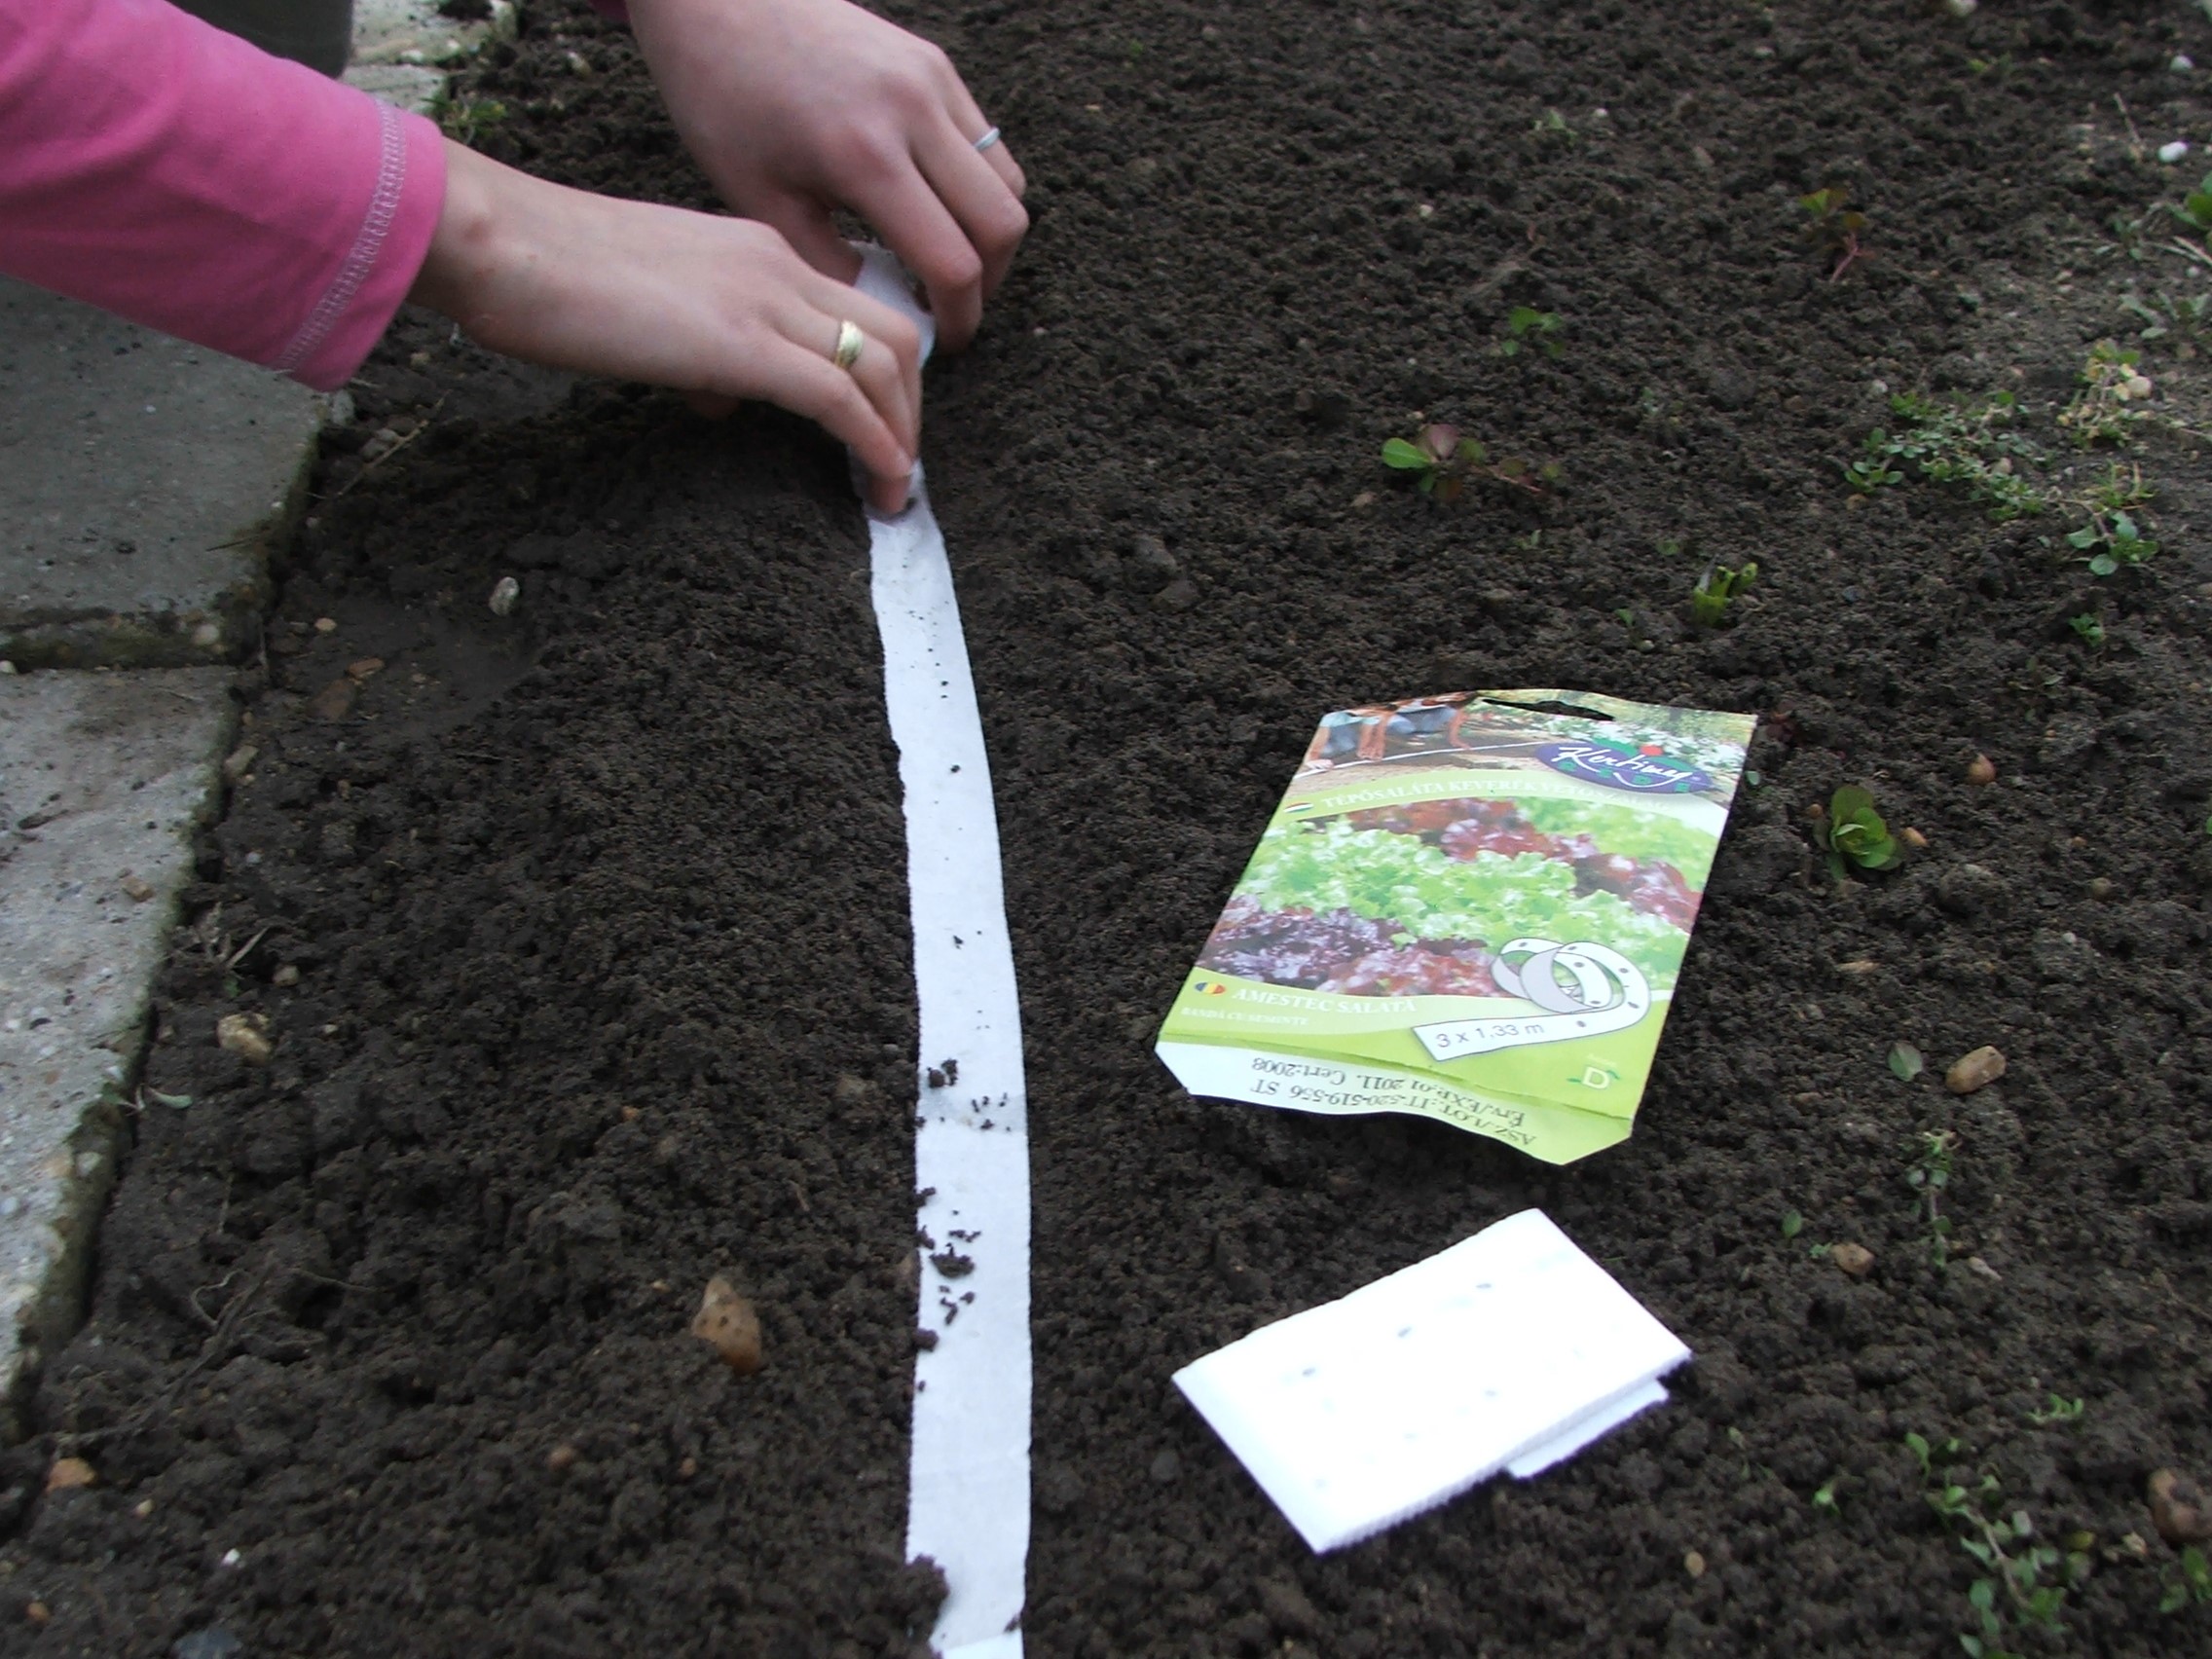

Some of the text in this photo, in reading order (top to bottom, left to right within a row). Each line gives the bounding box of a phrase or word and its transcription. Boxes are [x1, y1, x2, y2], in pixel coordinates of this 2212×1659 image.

[1232, 988, 1333, 1012] AMESTEC
[1436, 1022, 1545, 1048] 3 x 1,33 m
[1250, 1079, 1280, 1095] ST
[1582, 1066, 1610, 1089] D
